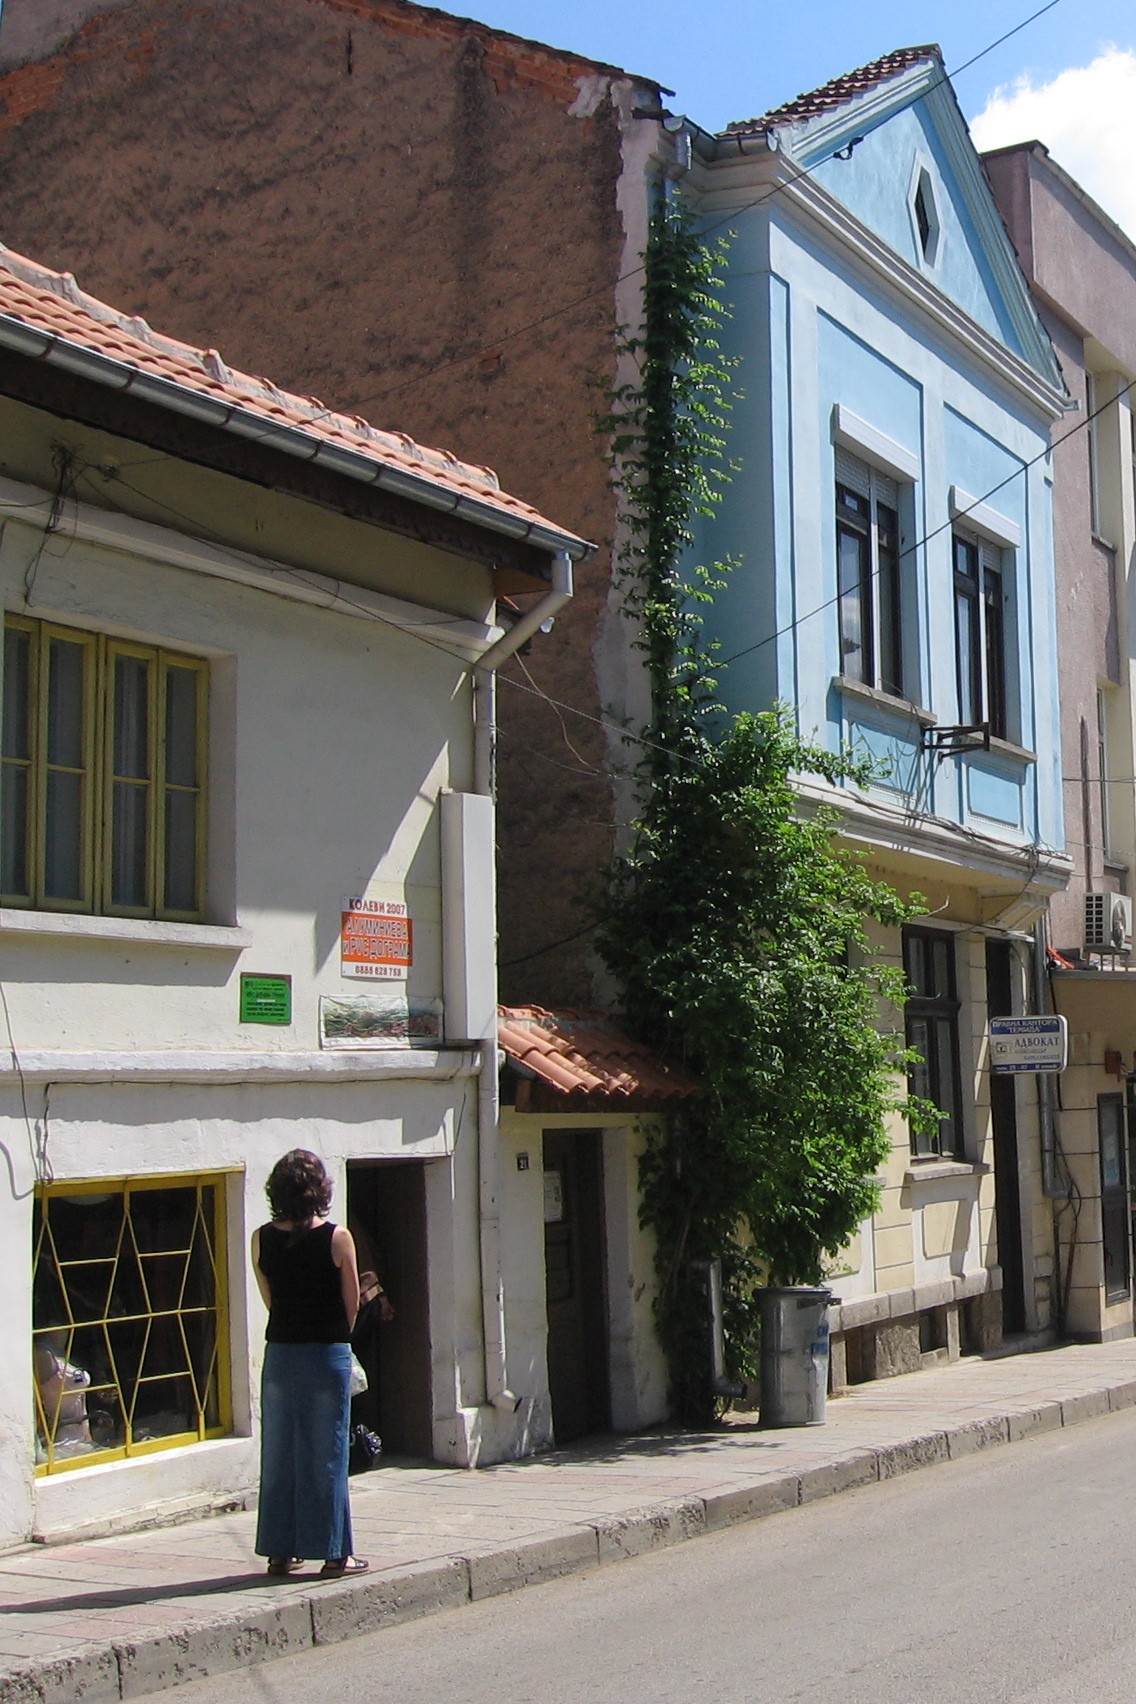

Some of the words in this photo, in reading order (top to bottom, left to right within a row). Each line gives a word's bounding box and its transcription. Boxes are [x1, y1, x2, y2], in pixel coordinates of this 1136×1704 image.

[349, 899, 385, 913] КОЛЕВИ
[387, 902, 405, 915] 2007
[1014, 1037, 1060, 1048] АДВОКАТ
